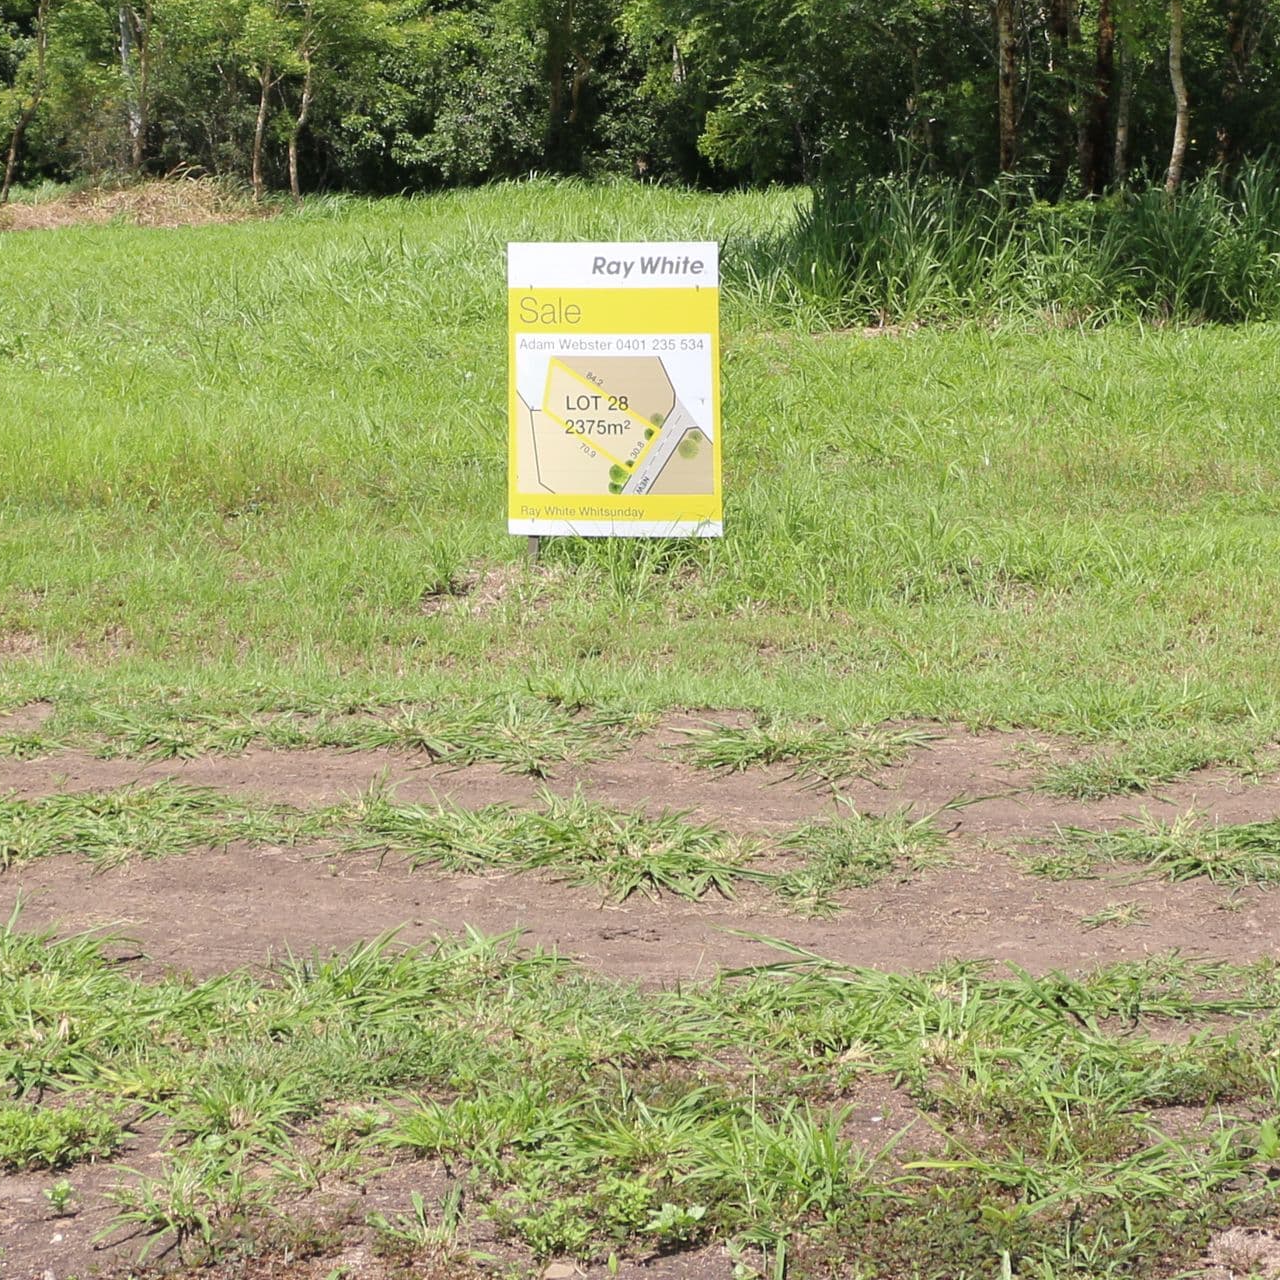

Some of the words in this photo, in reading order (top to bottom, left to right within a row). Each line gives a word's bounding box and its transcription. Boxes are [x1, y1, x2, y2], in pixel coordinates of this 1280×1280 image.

[592, 256, 634, 278] Ray
[640, 256, 704, 275] White
[519, 296, 581, 325] Sale
[519, 338, 555, 351] Adam
[559, 338, 611, 351] Webster
[616, 338, 646, 351] 0401
[652, 338, 676, 351] 235
[680, 338, 704, 351] 534
[566, 395, 601, 411] LOT
[607, 395, 629, 411] 28
[579, 443, 597, 459] 70.9
[630, 441, 645, 460] 30.8
[520, 505, 540, 517] Ray
[544, 506, 576, 516] White
[578, 506, 645, 519] Whitsunday
